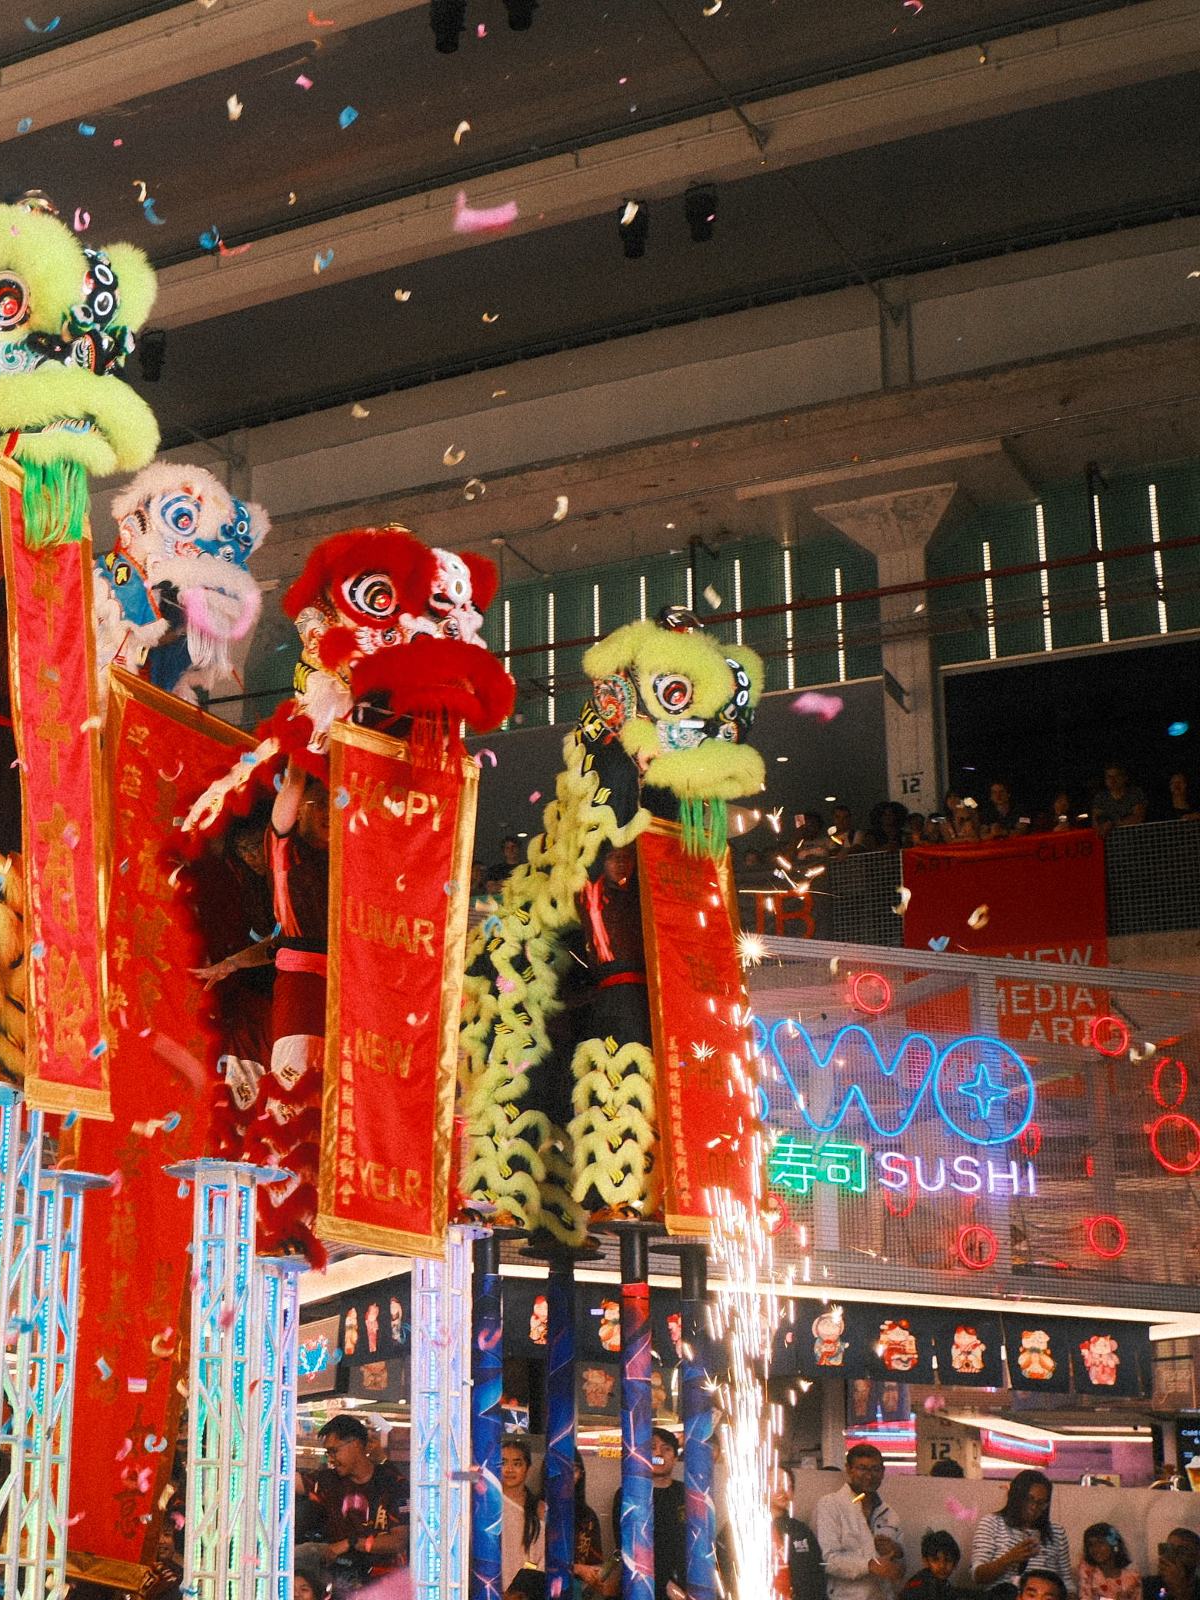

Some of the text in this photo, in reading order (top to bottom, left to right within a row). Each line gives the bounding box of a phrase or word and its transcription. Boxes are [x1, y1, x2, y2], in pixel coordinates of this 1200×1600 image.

[350, 771, 450, 833] HAPPY
[901, 777, 921, 795] 12
[346, 896, 436, 958] LUNAR
[354, 1027, 415, 1079] NEW
[1027, 1014, 1098, 1047] ART
[355, 1158, 424, 1209] YEAR
[769, 1140, 868, 1194] 寿司
[878, 1151, 1038, 1196] SUSHI
[930, 1442, 951, 1460] 12
